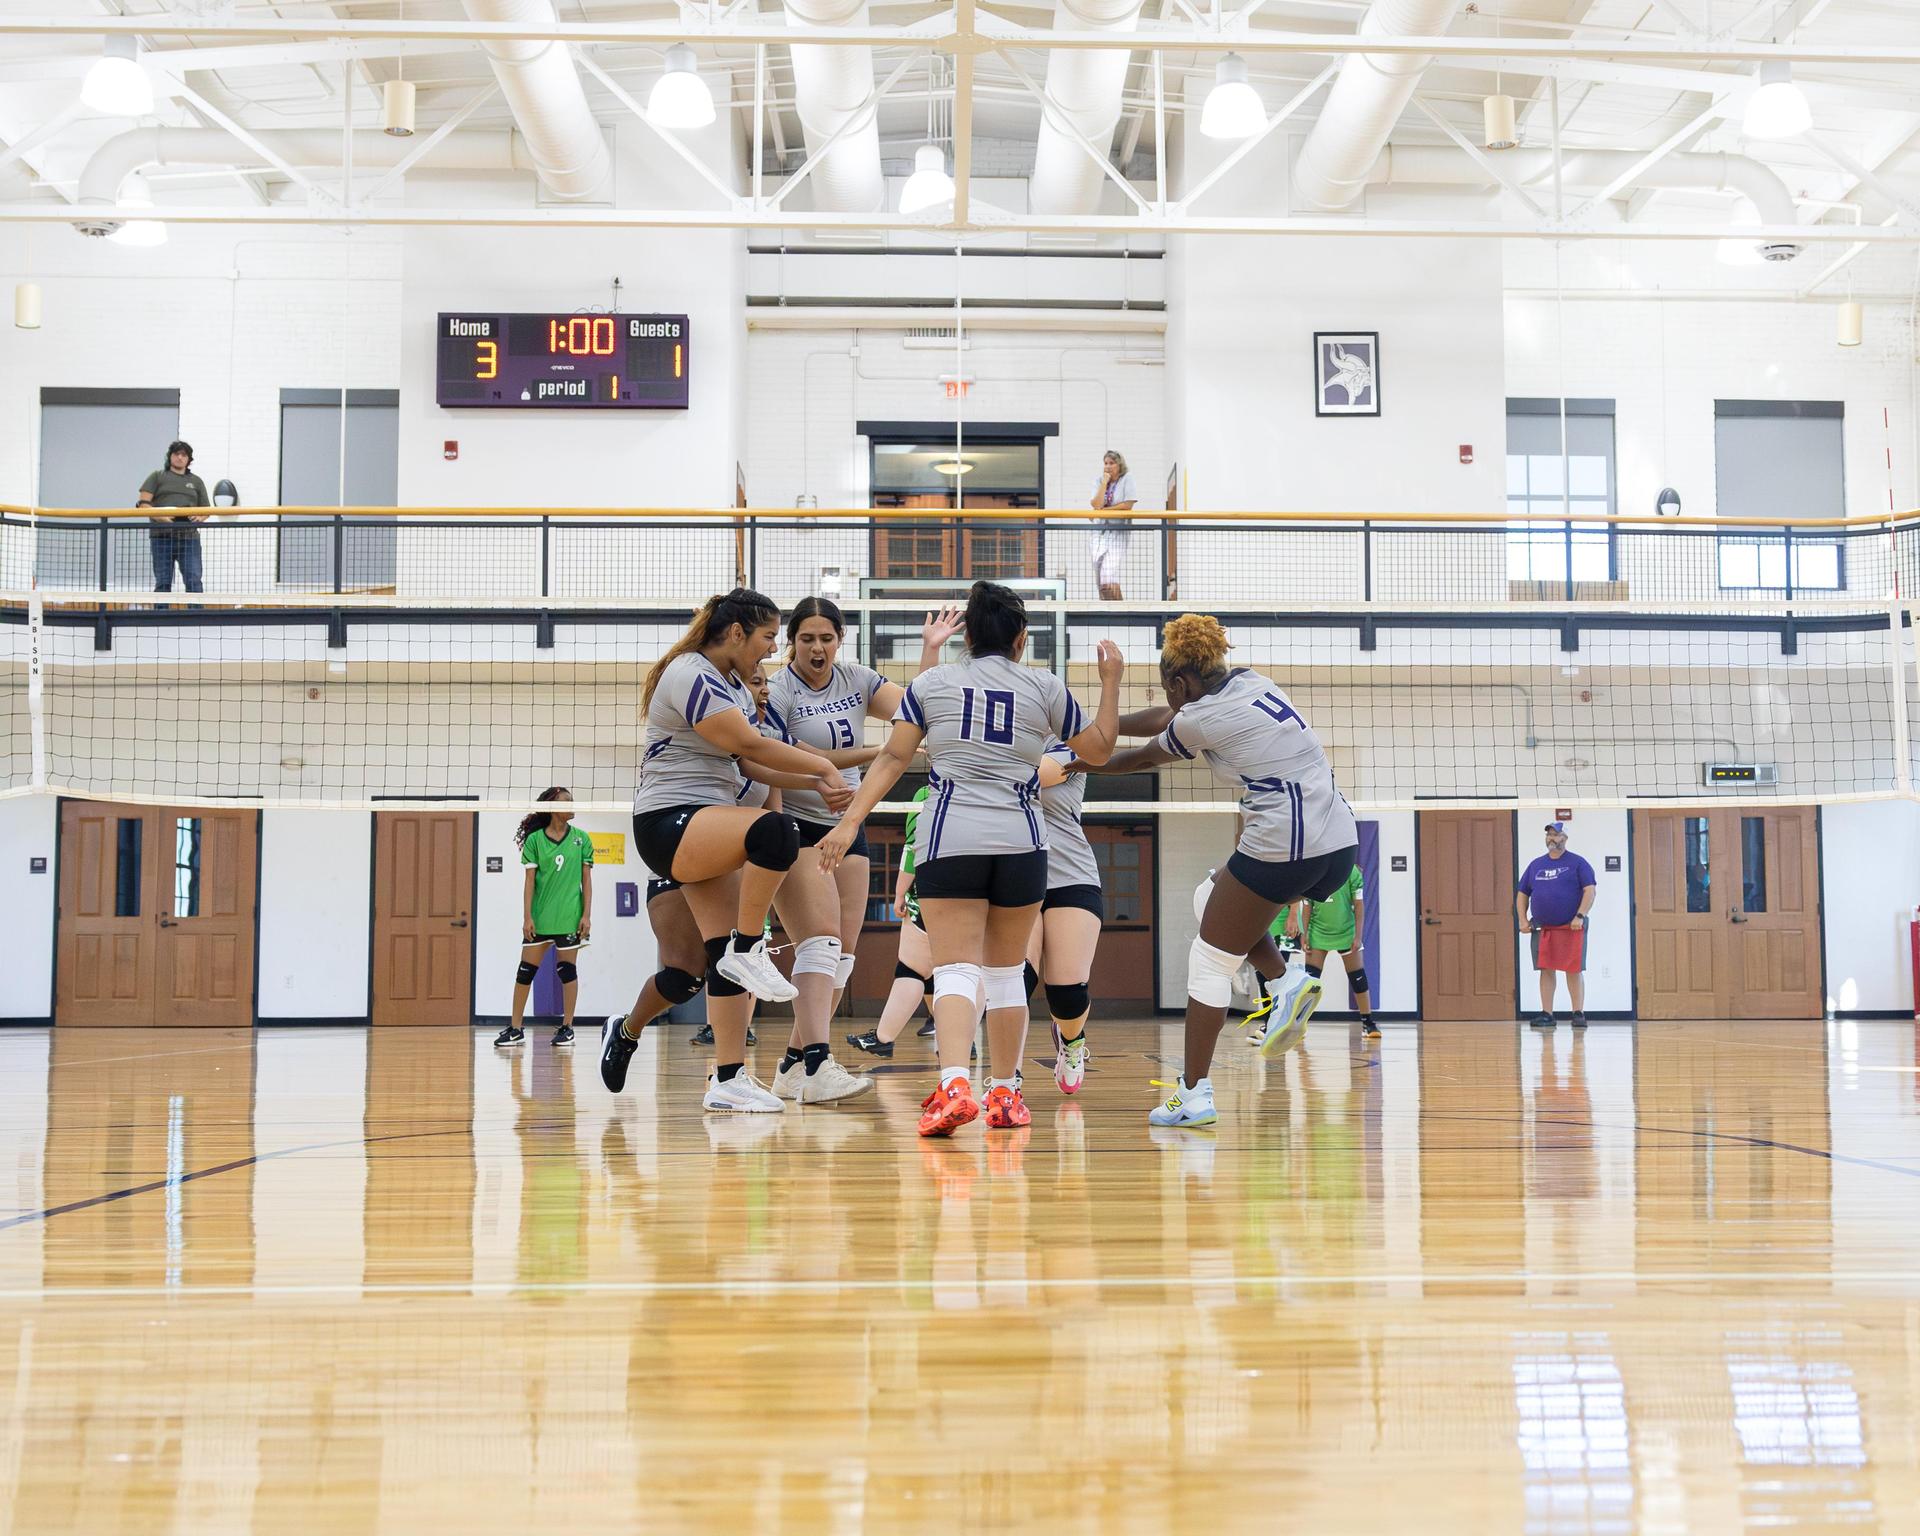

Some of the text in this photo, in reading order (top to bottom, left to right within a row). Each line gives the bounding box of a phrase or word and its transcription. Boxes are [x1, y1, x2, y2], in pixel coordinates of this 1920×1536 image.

[450, 319, 490, 336] Home
[549, 318, 614, 355] 1:00
[629, 319, 681, 337] Guests
[476, 341, 497, 378] 3
[675, 345, 682, 378] 1
[538, 379, 585, 400] period
[612, 375, 618, 400] 1
[945, 382, 970, 398] EXT
[797, 691, 863, 718] TENNESSEE
[959, 686, 1016, 747] 10
[1249, 690, 1308, 732] 4
[826, 718, 855, 750] 13
[555, 854, 564, 872] 9
